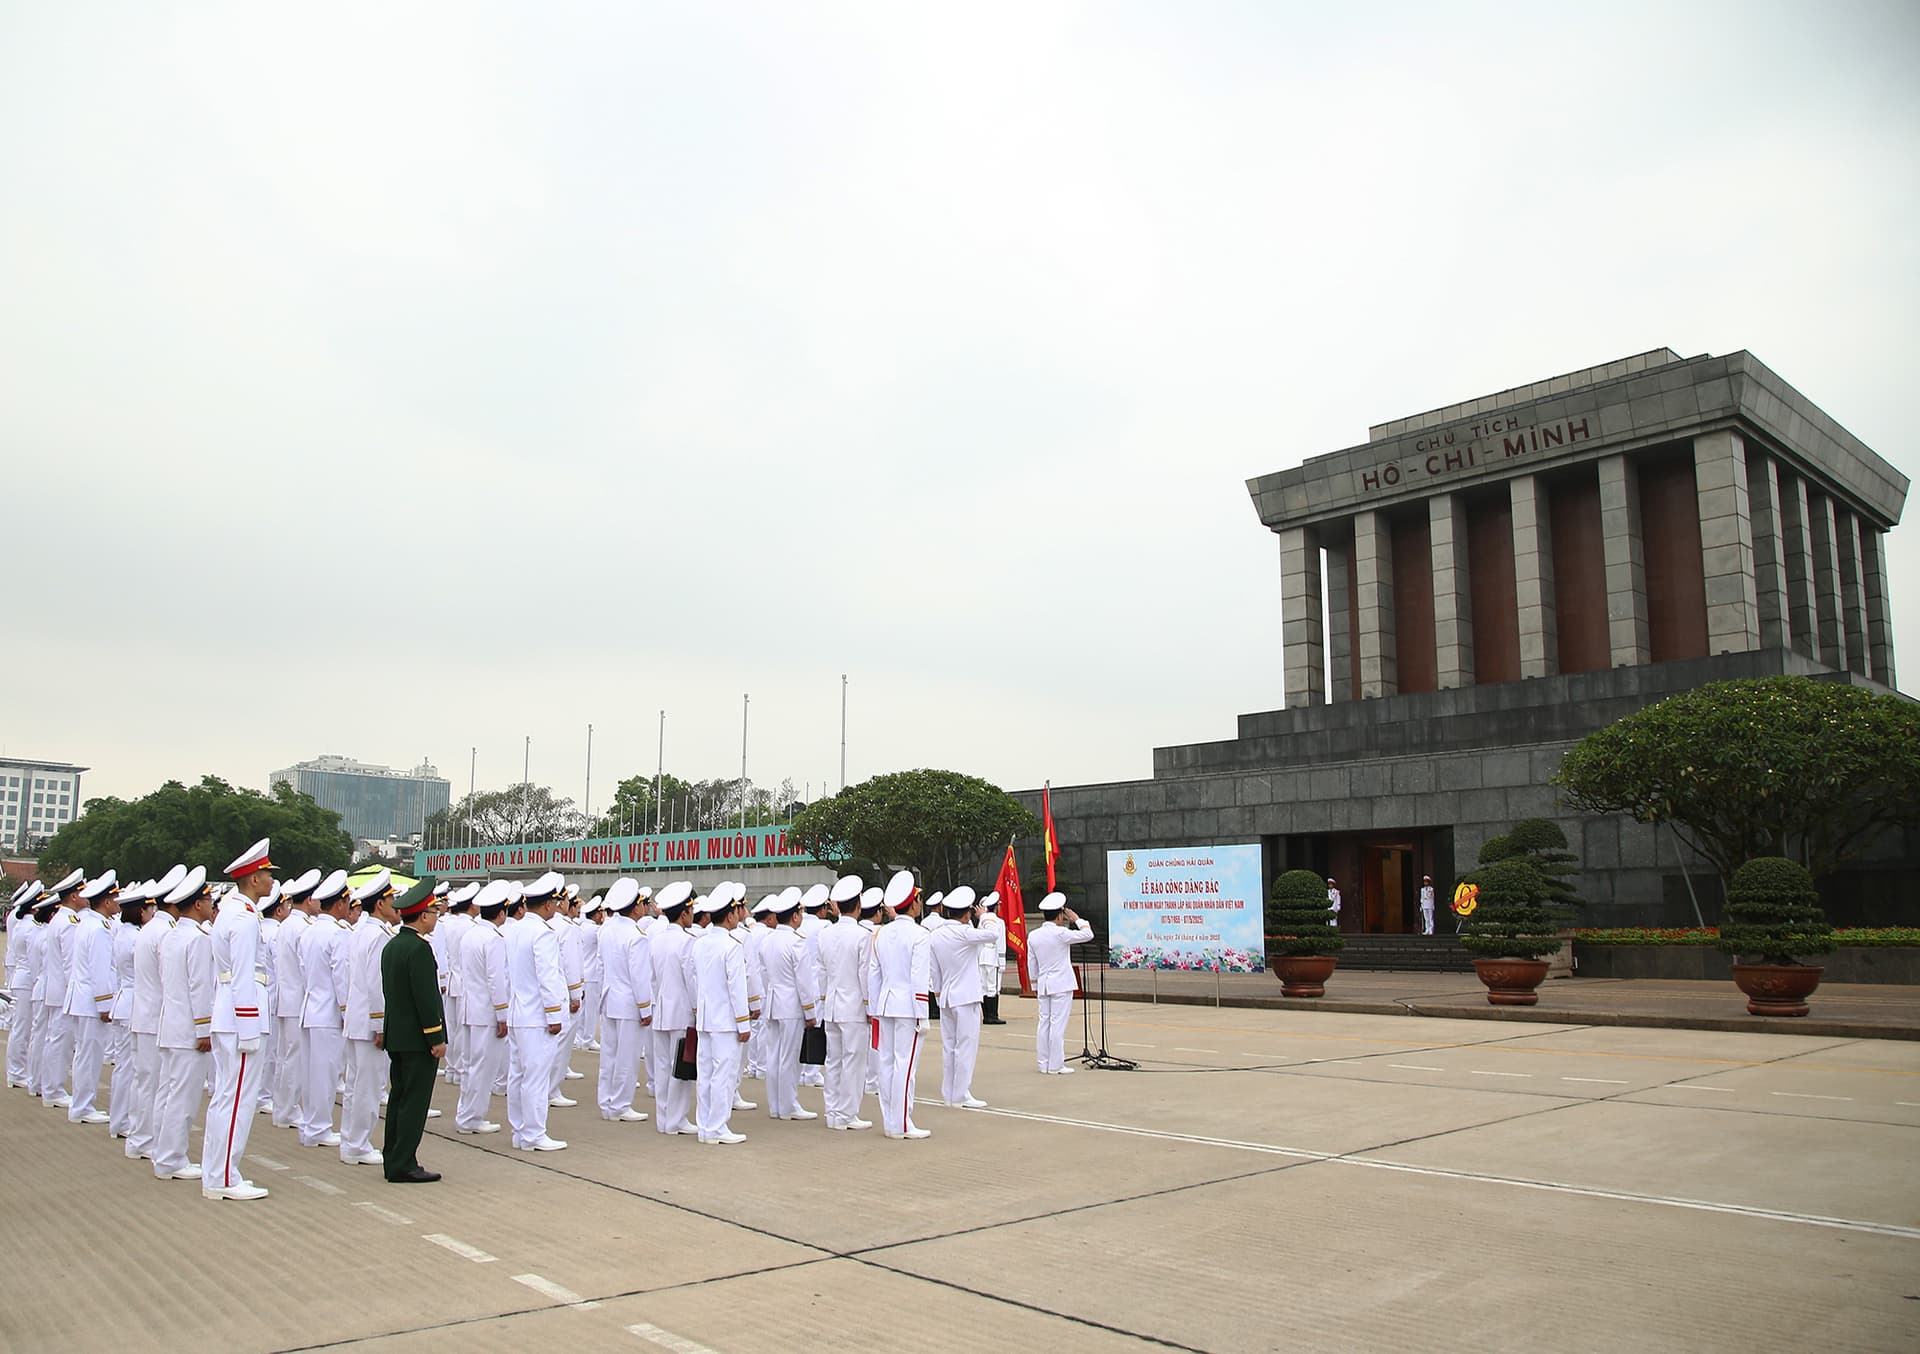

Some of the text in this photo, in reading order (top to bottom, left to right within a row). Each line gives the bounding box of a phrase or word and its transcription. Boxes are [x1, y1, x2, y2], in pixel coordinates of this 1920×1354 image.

[426, 852, 451, 872] NƯỚC
[454, 850, 481, 873] CỘNG
[510, 847, 523, 865] XÃ
[581, 841, 622, 864] NGHĨA
[629, 838, 660, 867] VIỆT
[665, 839, 700, 862] NAM
[707, 831, 757, 860] MUÔN
[1148, 857, 1214, 868] QUÂN CHỦNG HẢI QUÂN
[1165, 878, 1183, 894] CÔNG
[1205, 877, 1219, 893] BÁC
